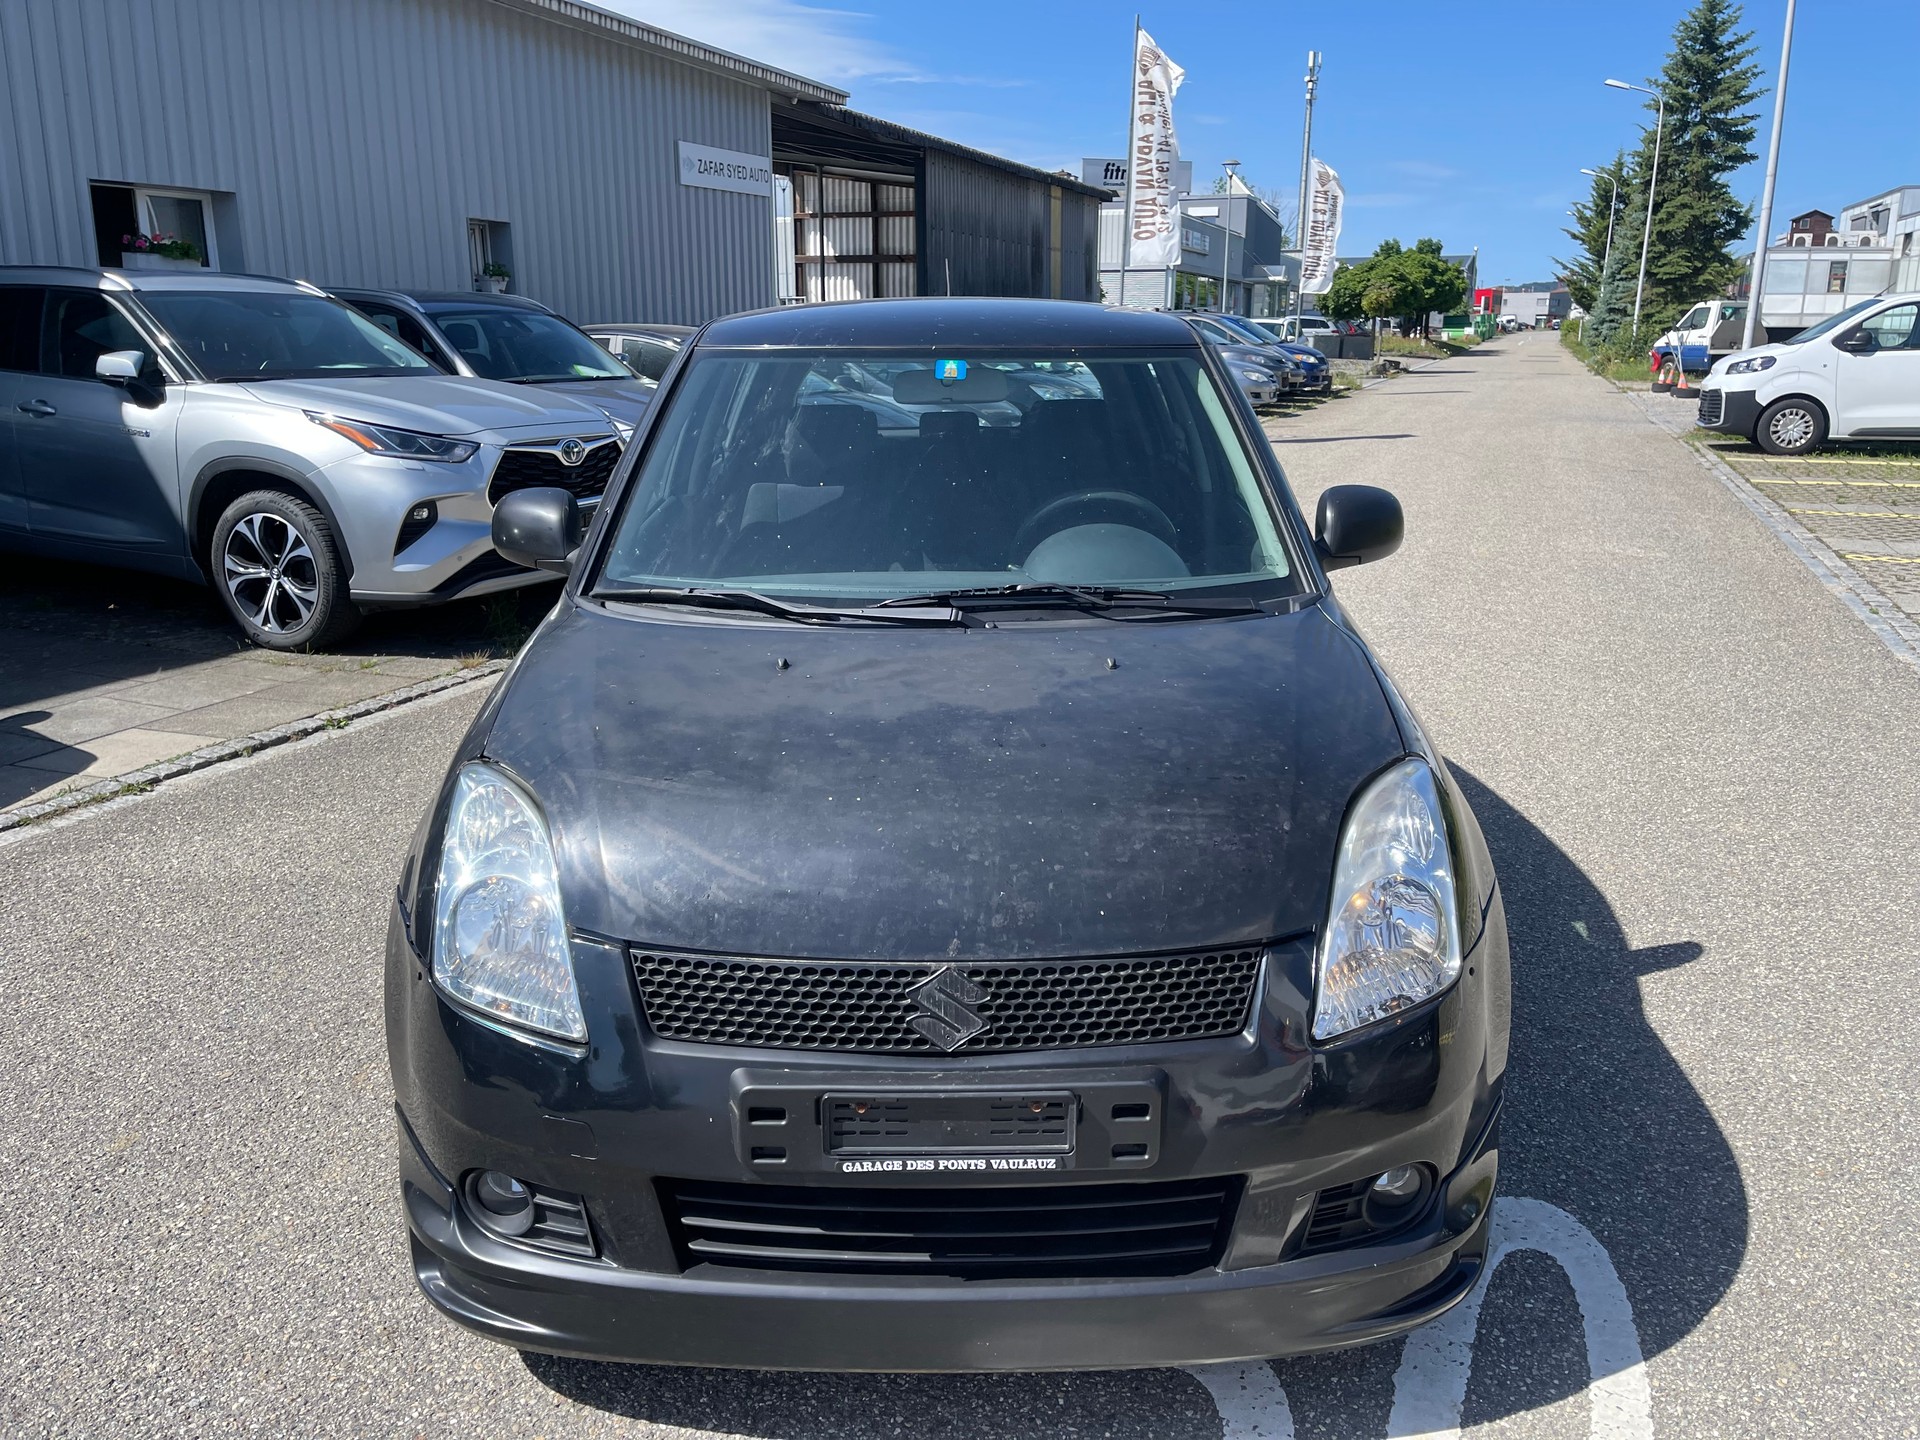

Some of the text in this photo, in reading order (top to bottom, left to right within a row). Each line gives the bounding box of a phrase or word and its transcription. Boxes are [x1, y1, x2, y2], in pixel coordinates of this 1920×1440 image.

[697, 159, 769, 183] ZAFAR SYED AUTO
[842, 1158, 1056, 1173] GARAGE DES PONTS VAULRUZ
